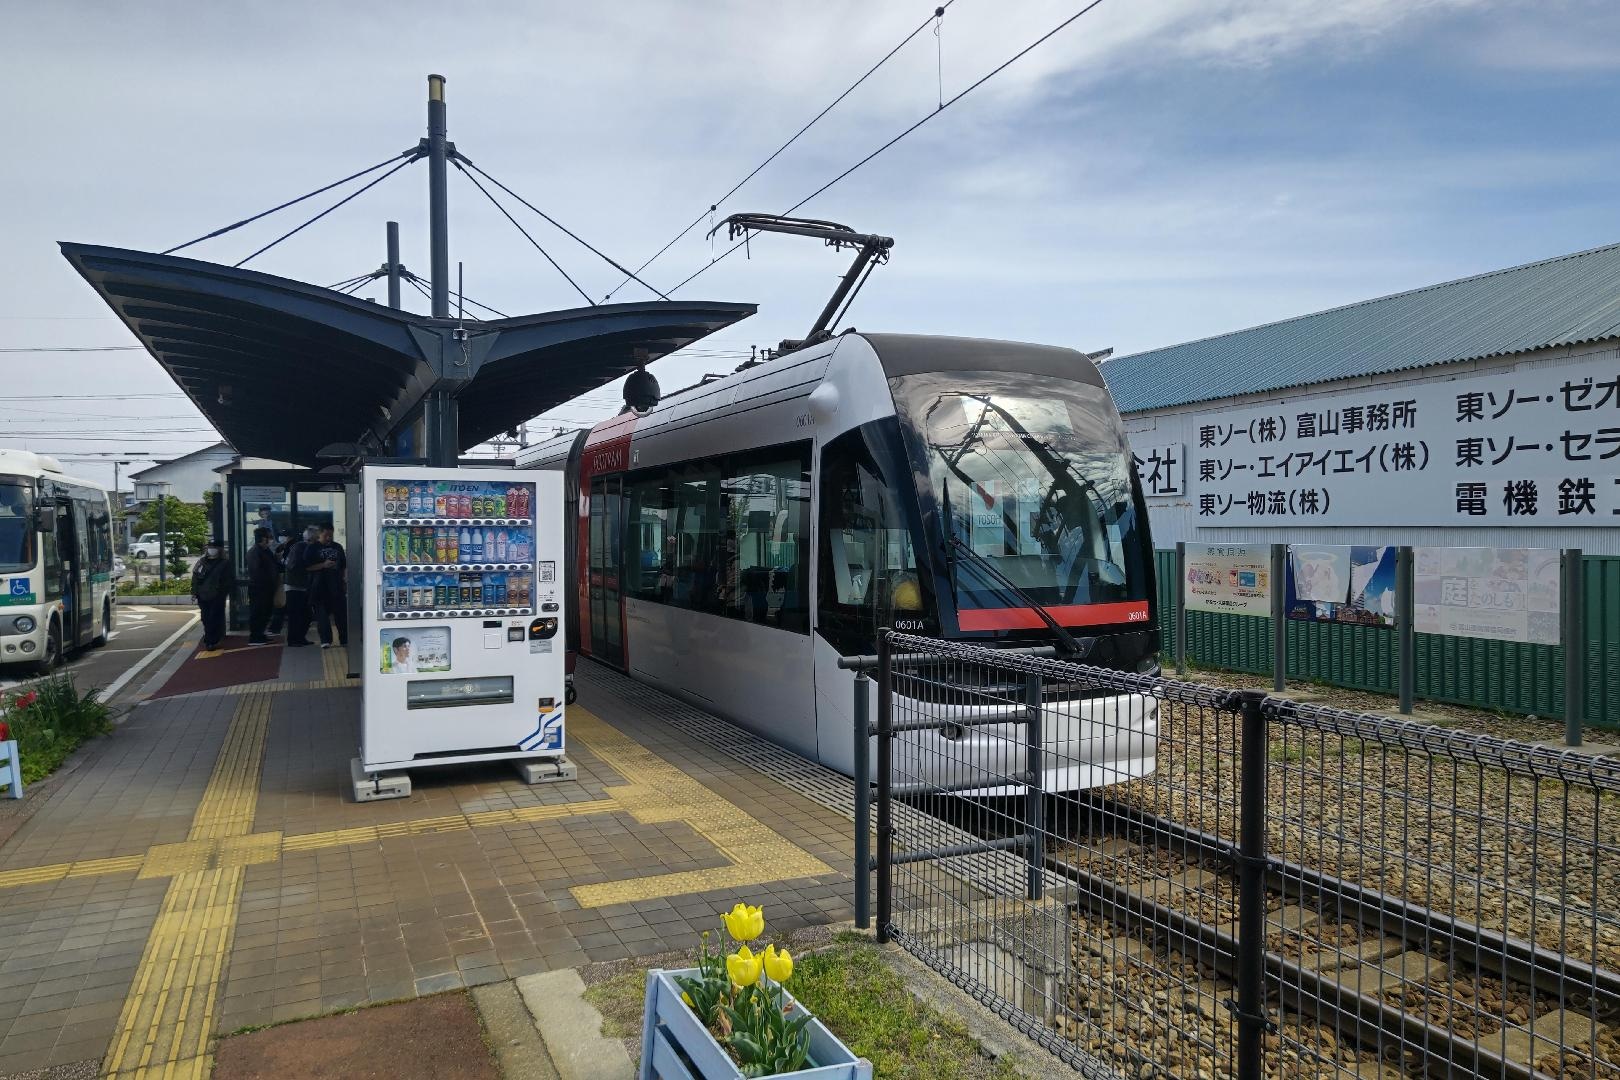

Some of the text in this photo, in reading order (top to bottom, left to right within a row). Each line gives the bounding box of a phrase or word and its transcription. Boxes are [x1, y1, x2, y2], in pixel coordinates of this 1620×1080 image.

[1296, 399, 1417, 439] 富山事務所
[1199, 487, 1330, 516] 東ソー物流(株)
[1456, 477, 1620, 516] 電機鉄
[895, 620, 924, 630] 0601A
[1128, 610, 1147, 621] 0601A
